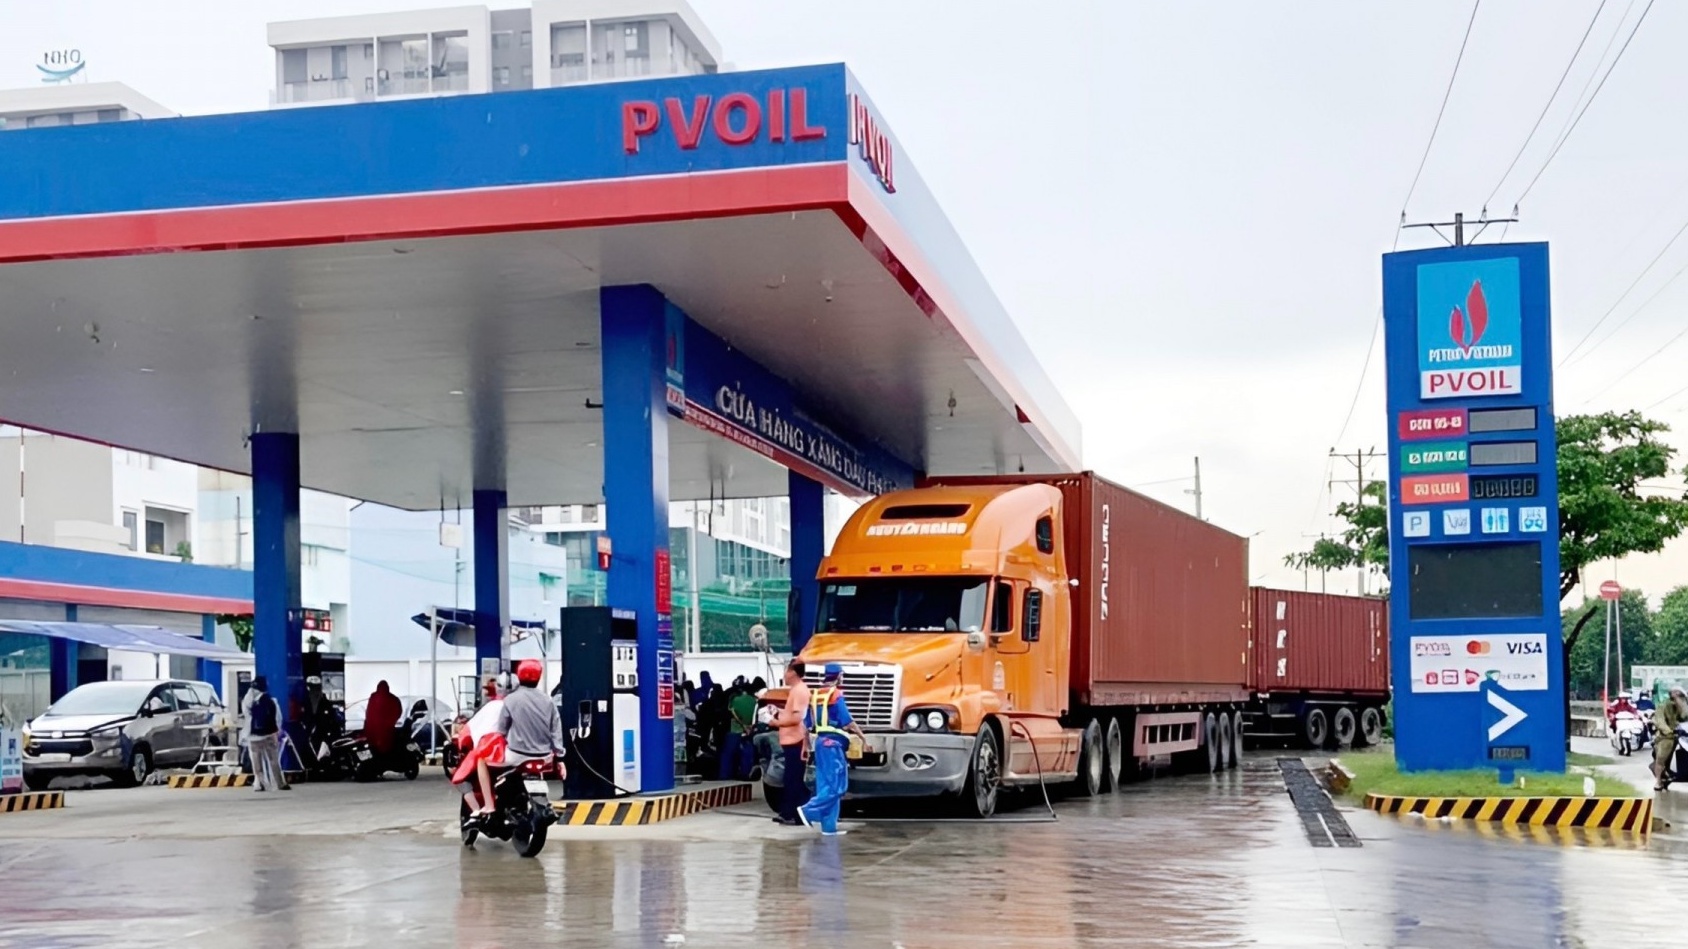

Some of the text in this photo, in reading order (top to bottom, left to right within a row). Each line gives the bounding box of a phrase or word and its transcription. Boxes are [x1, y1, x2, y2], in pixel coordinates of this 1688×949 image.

[621, 86, 827, 155] PVOIL
[1430, 370, 1513, 393] PVOIL
[1507, 642, 1543, 655] VISA
